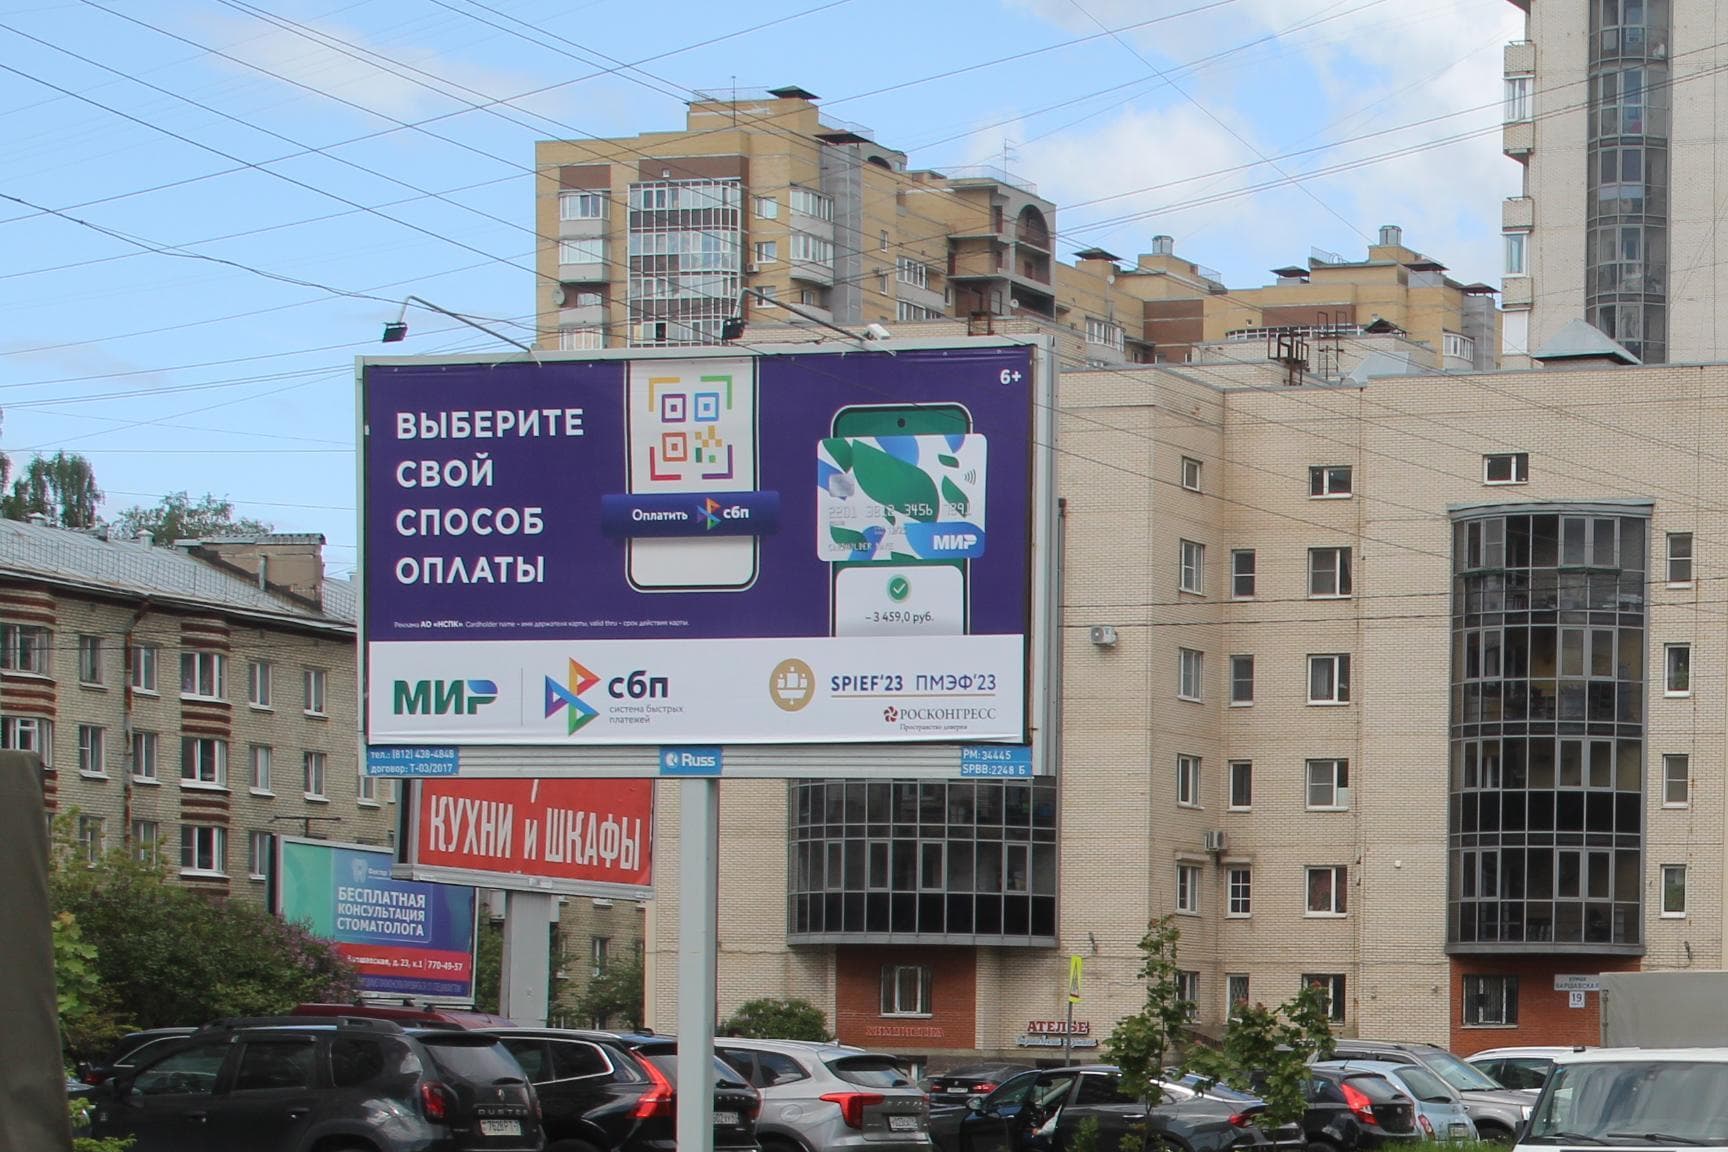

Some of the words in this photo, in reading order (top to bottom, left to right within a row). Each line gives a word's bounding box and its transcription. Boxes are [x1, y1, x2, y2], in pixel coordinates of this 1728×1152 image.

[1000, 369, 1021, 384] 6+
[397, 408, 584, 440] ВЫБЕРИТЕ
[396, 452, 493, 488] СВОЙ
[632, 508, 688, 521] Оплатить
[723, 506, 750, 519] сбп
[396, 507, 544, 536] СПОСОБ
[933, 534, 977, 550] МИР
[396, 556, 545, 584] ОПЛАТЫ
[421, 620, 432, 629] АО
[873, 611, 880, 622] 3
[882, 611, 910, 623] 459,0
[913, 611, 934, 624] руб.
[608, 670, 669, 699] сбп
[394, 680, 498, 715] МИР
[609, 704, 644, 714] система
[646, 703, 684, 716] быстрых
[900, 708, 997, 721] РОСКОНГРЕСС
[609, 715, 651, 725] платежей
[370, 751, 391, 759] тел.:
[681, 753, 716, 767] Russ
[371, 765, 408, 774] договор:
[430, 795, 513, 858] КУХНИ
[524, 818, 537, 860] и
[545, 807, 641, 871] ШКАФЫ
[338, 886, 425, 908] БЕСПЛАТНАЯ
[338, 902, 425, 923] КОНСУЛЬТАЦИЯ
[336, 917, 424, 937] СТОМАТОЛОГА
[1572, 993, 1582, 1002] 19
[1027, 1021, 1088, 1034] АТЕЛЬЕ
